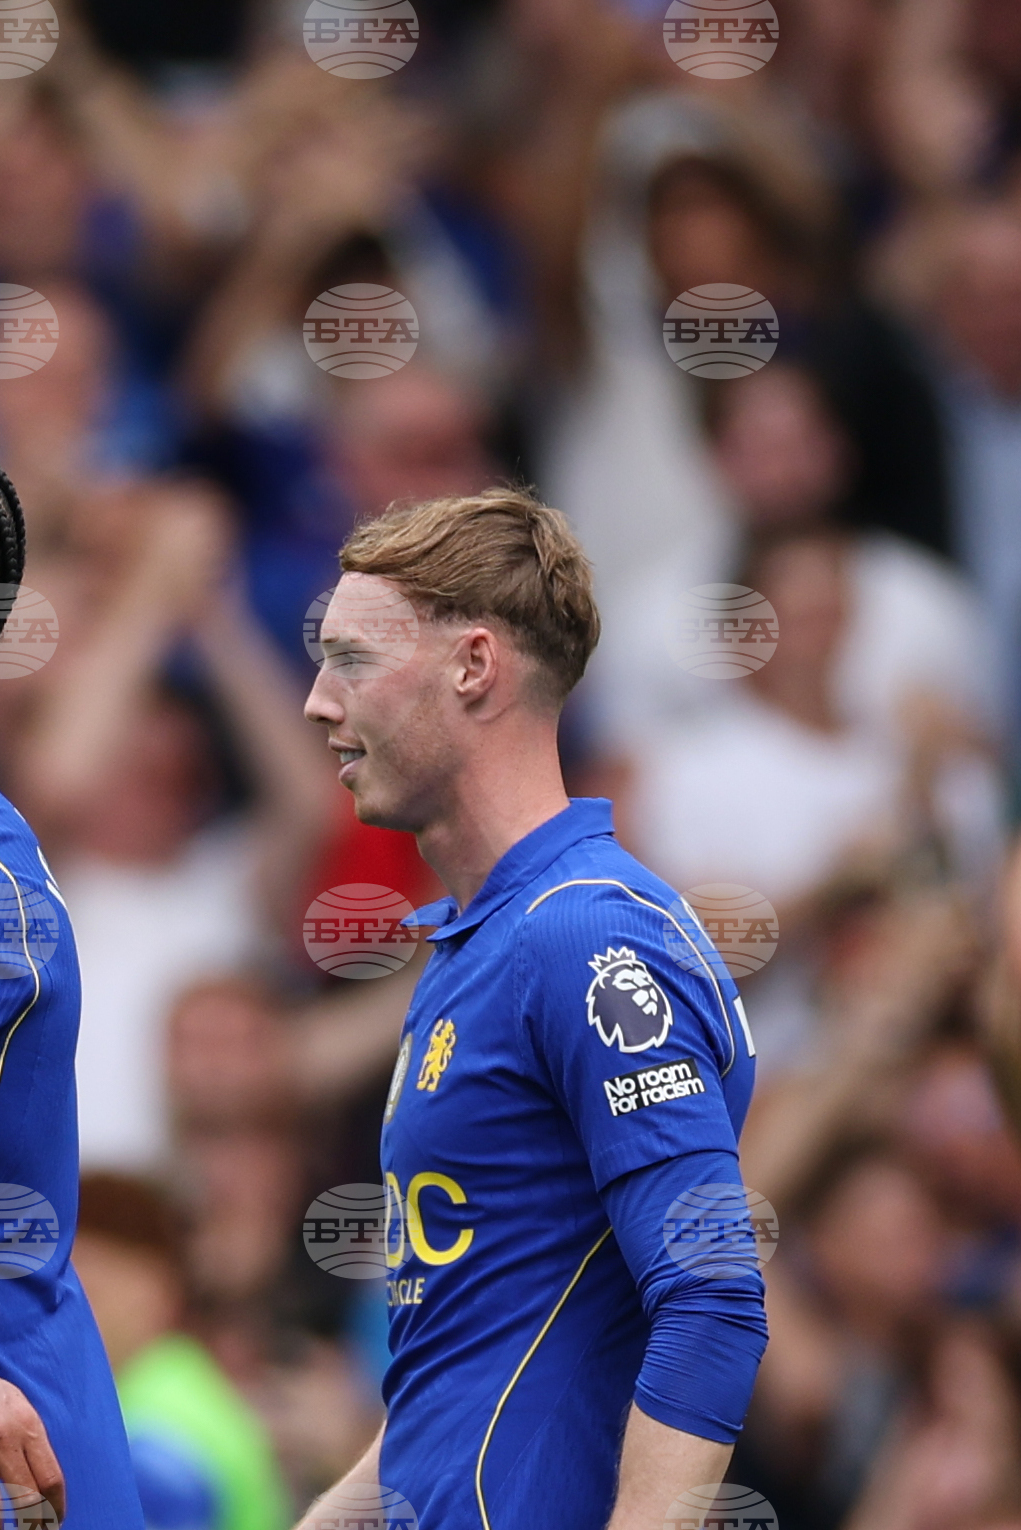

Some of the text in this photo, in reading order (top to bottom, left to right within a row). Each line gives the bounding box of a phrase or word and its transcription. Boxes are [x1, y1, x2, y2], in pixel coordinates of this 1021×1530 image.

[603, 1063, 692, 1100] No room
[609, 1077, 705, 1117] for racism
